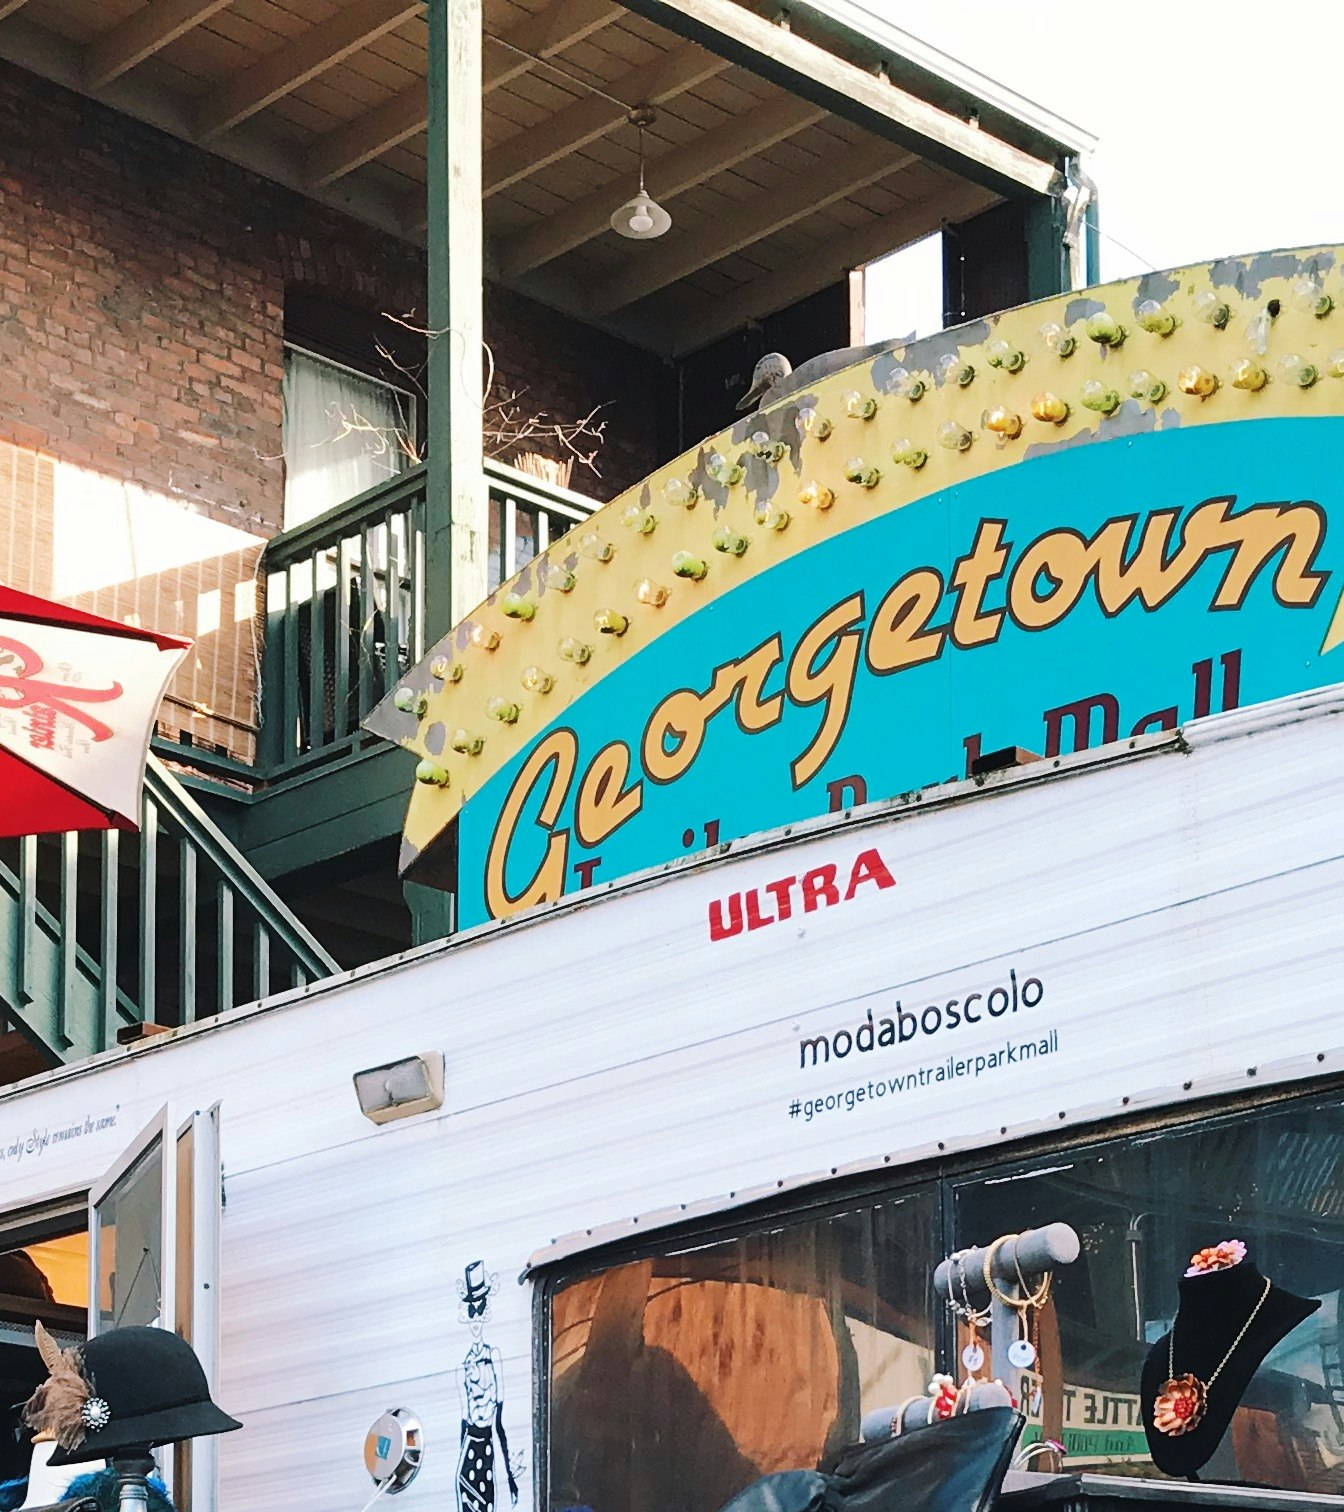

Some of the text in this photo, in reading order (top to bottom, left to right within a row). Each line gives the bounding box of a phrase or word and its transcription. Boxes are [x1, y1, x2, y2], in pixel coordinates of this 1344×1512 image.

[484, 495, 1332, 920] Georgetown
[709, 848, 896, 942] ULTRA
[800, 968, 1044, 1068] modaboscolo
[788, 1029, 1058, 1122] #georgetowntrailerparkmall
